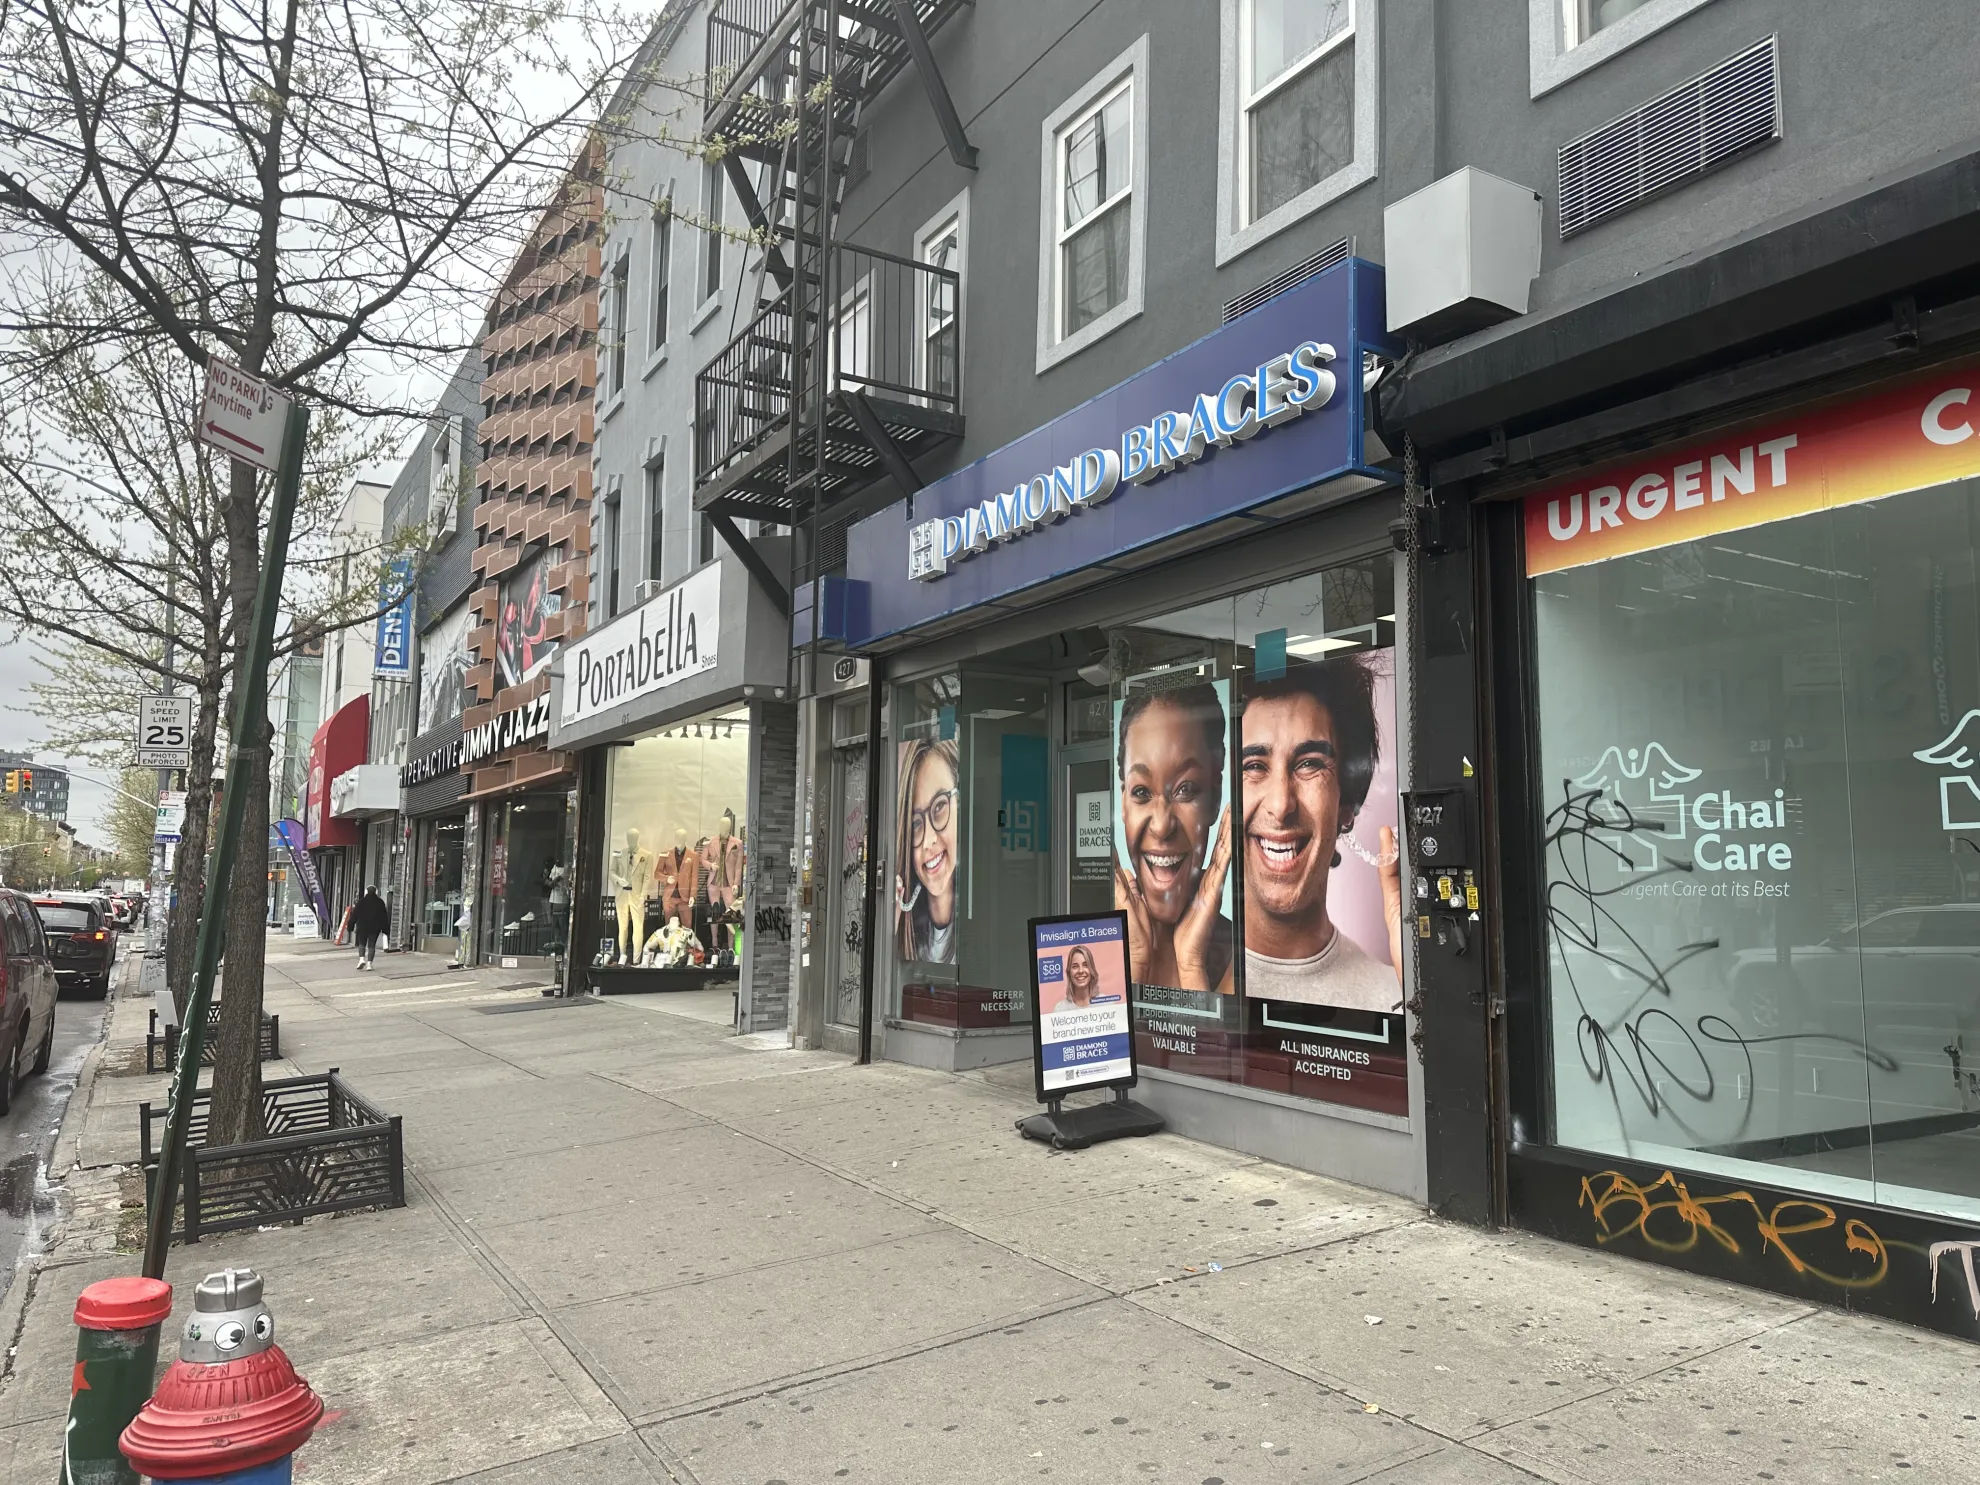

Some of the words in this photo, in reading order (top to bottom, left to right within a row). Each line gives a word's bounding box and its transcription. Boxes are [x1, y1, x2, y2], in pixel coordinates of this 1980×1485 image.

[212, 366, 228, 387] NO
[230, 376, 273, 411] PARKIG
[209, 387, 252, 420] Anytime
[941, 447, 1119, 562] DIAMOND
[1121, 340, 1336, 486] BRACES
[1547, 433, 1798, 541] URGENT
[1920, 387, 1980, 445] C
[701, 654, 717, 669] Shoes
[838, 661, 851, 676] 427
[1089, 700, 1108, 717] 427
[146, 725, 184, 746] 25
[459, 714, 503, 765] JIMMY
[503, 692, 550, 748] JAZZ
[1692, 788, 1785, 831] Chai
[1080, 826, 1111, 836] DIAMOND
[1080, 836, 1111, 848] BRACES
[1694, 833, 1792, 871] Care
[1672, 881, 1707, 897] Care
[1711, 883, 1727, 897] at
[1731, 881, 1750, 897] its
[1753, 881, 1790, 897] Best
[1081, 928, 1087, 938] &
[1088, 927, 1118, 937] Braces
[1043, 963, 1061, 976] $89
[992, 990, 1025, 1000] REFERR
[981, 1002, 1025, 1012] NECESSAR
[1051, 1015, 1088, 1027] Welcome
[1090, 1013, 1097, 1022] to
[1099, 1011, 1116, 1022] your
[1052, 1028, 1076, 1039] brand
[1077, 1026, 1094, 1034] new
[1095, 1022, 1116, 1031] smile
[1148, 1020, 1197, 1037] FINANCING
[1076, 1041, 1108, 1051] DIAMOND
[1076, 1048, 1108, 1060] BRACES
[1280, 1040, 1299, 1054] ALL
[1301, 1043, 1370, 1066] INSURANCES
[1295, 1060, 1351, 1081] ACCEPTED
